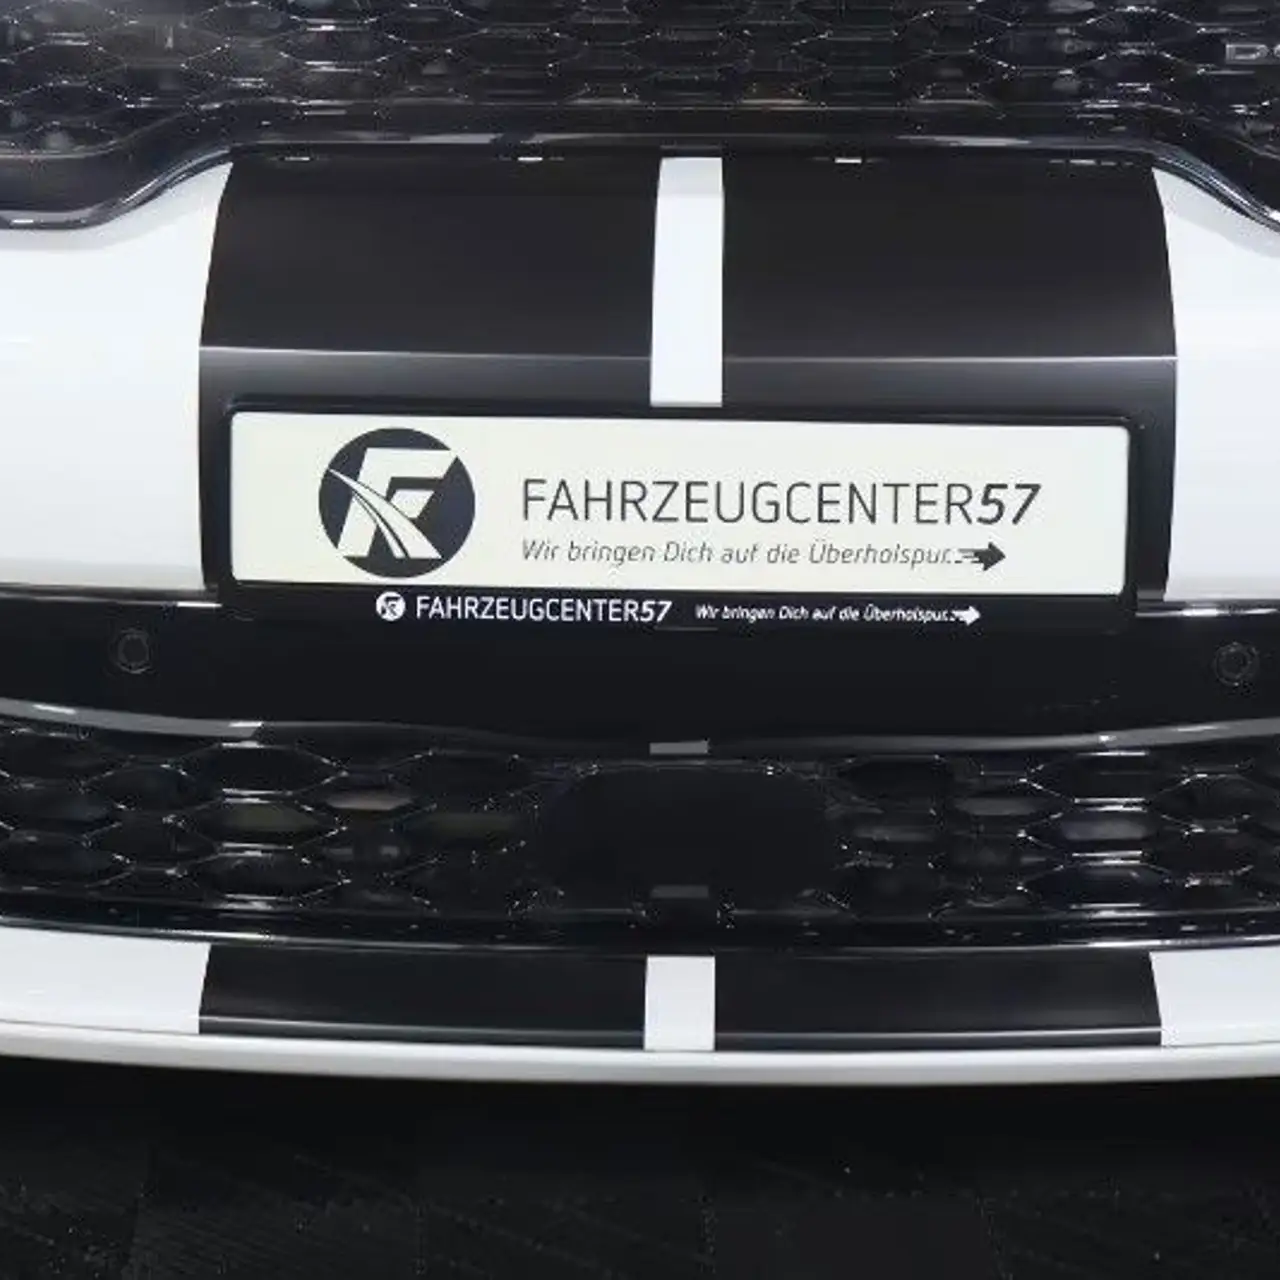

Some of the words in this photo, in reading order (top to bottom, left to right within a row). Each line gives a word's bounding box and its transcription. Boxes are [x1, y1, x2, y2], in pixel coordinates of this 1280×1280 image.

[522, 478, 1042, 526] FAHRZEUGCENTER57
[522, 538, 560, 562] Wir
[568, 539, 656, 567] bringen
[663, 541, 713, 563] Dich
[720, 542, 758, 565] auf
[766, 543, 801, 565] die
[416, 595, 673, 622] FAHRZEUGCENTER57
[695, 604, 721, 619] Wir
[721, 605, 776, 623] bringen
[778, 606, 810, 620] Dich
[811, 606, 837, 621] auf
[839, 606, 861, 621] die
